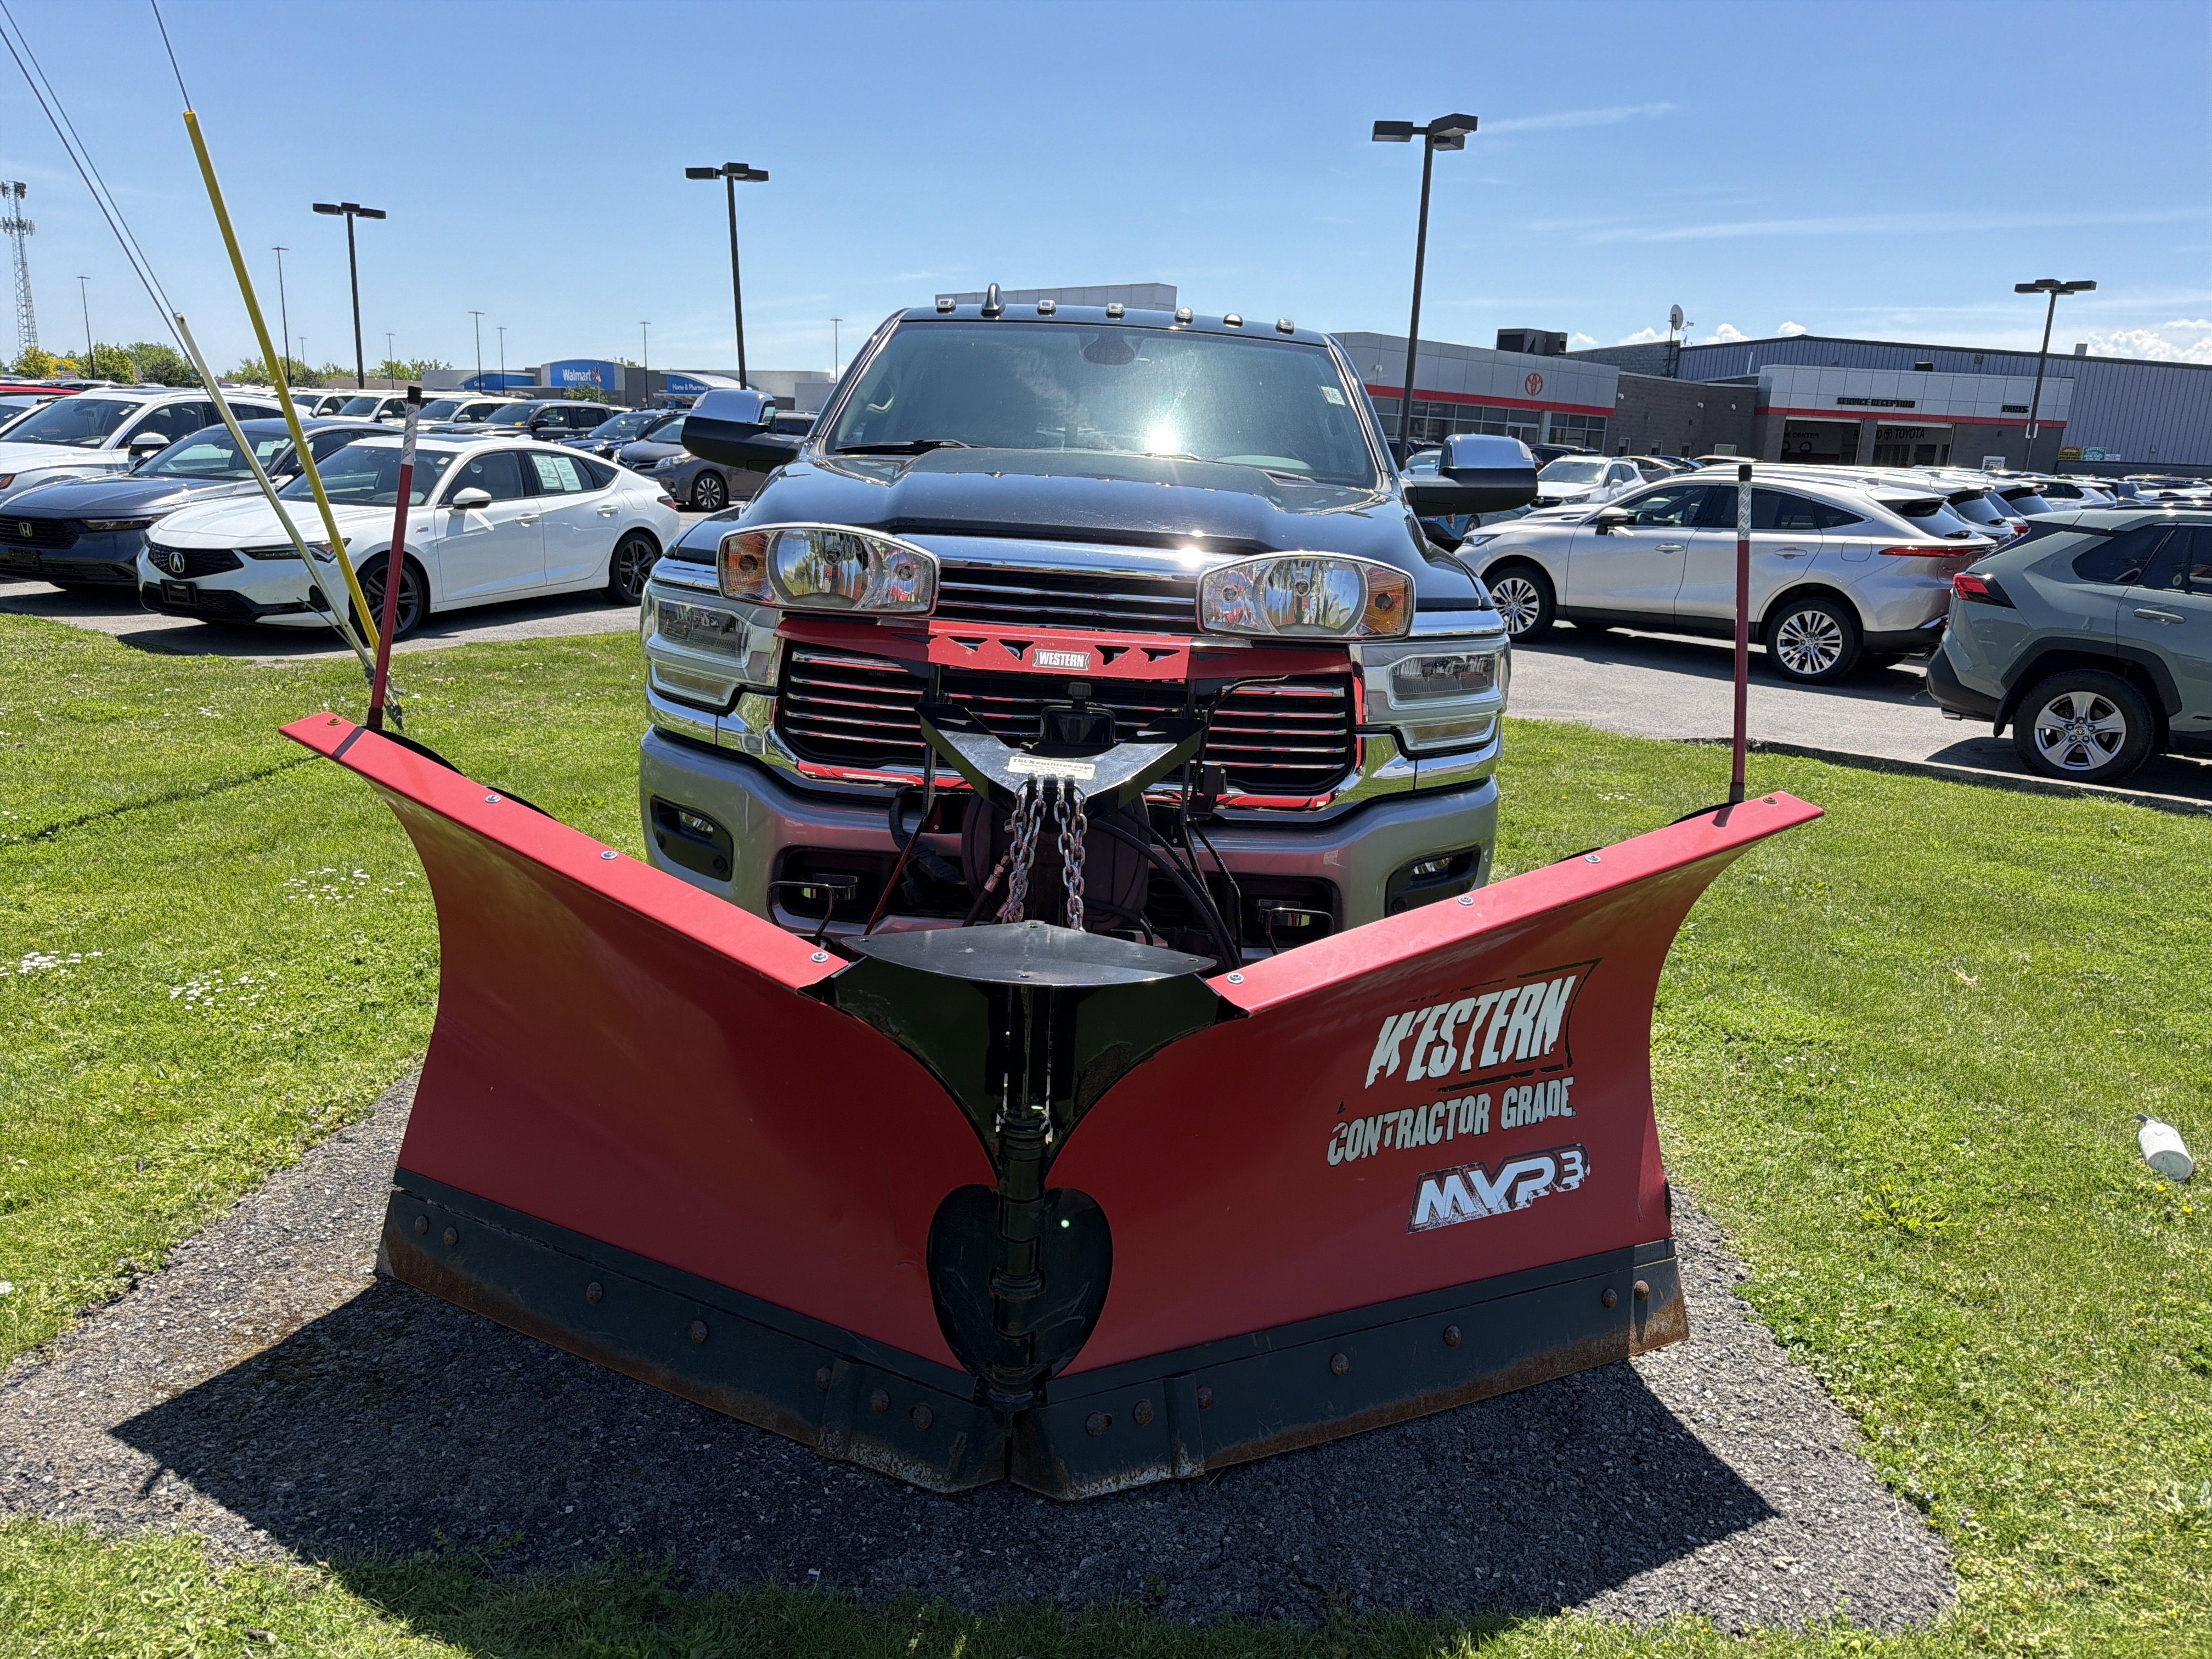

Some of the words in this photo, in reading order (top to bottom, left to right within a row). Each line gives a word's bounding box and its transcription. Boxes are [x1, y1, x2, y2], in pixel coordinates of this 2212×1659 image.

[562, 369, 592, 381] Walmart
[689, 383, 708, 392] Pharmacy
[1837, 397, 1870, 406] SERVICE
[1871, 398, 1916, 408] RECEPTION
[2001, 405, 2029, 414] PARTS
[1894, 427, 1925, 439] TOYOTA
[1039, 651, 1084, 668] WESTERN
[1364, 975, 1577, 1089] WESTERN
[1327, 1093, 1492, 1167] CONTRACTOR
[1500, 1076, 1575, 1130] GRADE
